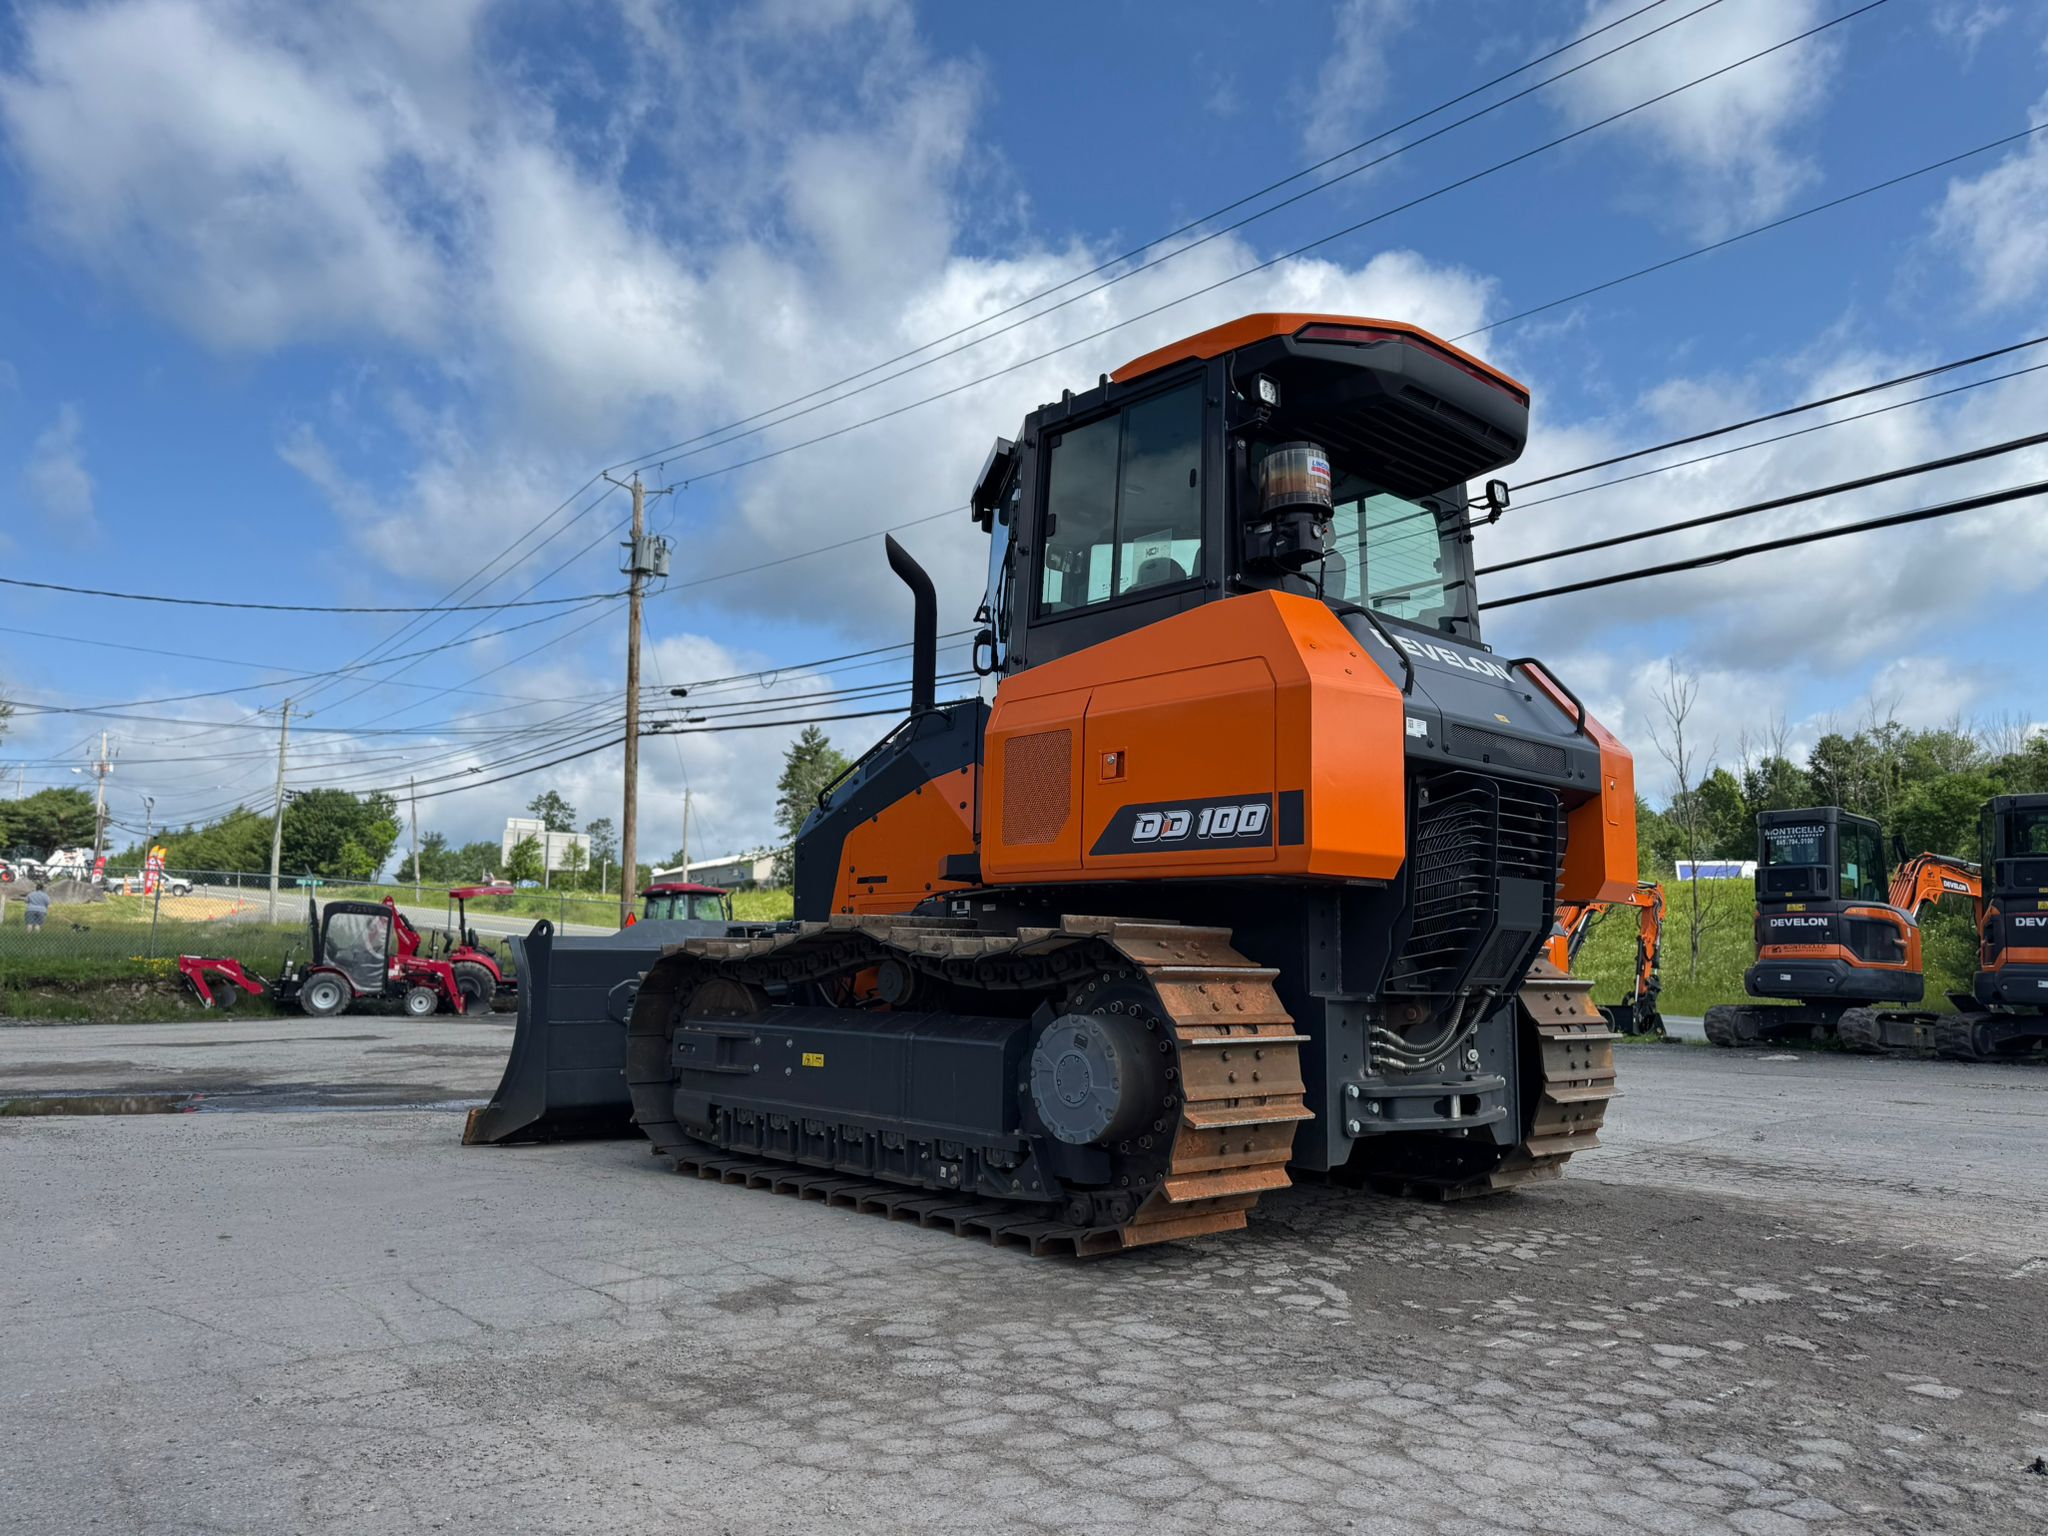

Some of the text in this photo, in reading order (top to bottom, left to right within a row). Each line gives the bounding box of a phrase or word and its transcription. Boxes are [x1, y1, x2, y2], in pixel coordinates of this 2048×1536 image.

[1132, 803, 1271, 844] DD 100
[1764, 825, 1826, 836] MONTICELLO
[1770, 917, 1828, 928] DEVELON
